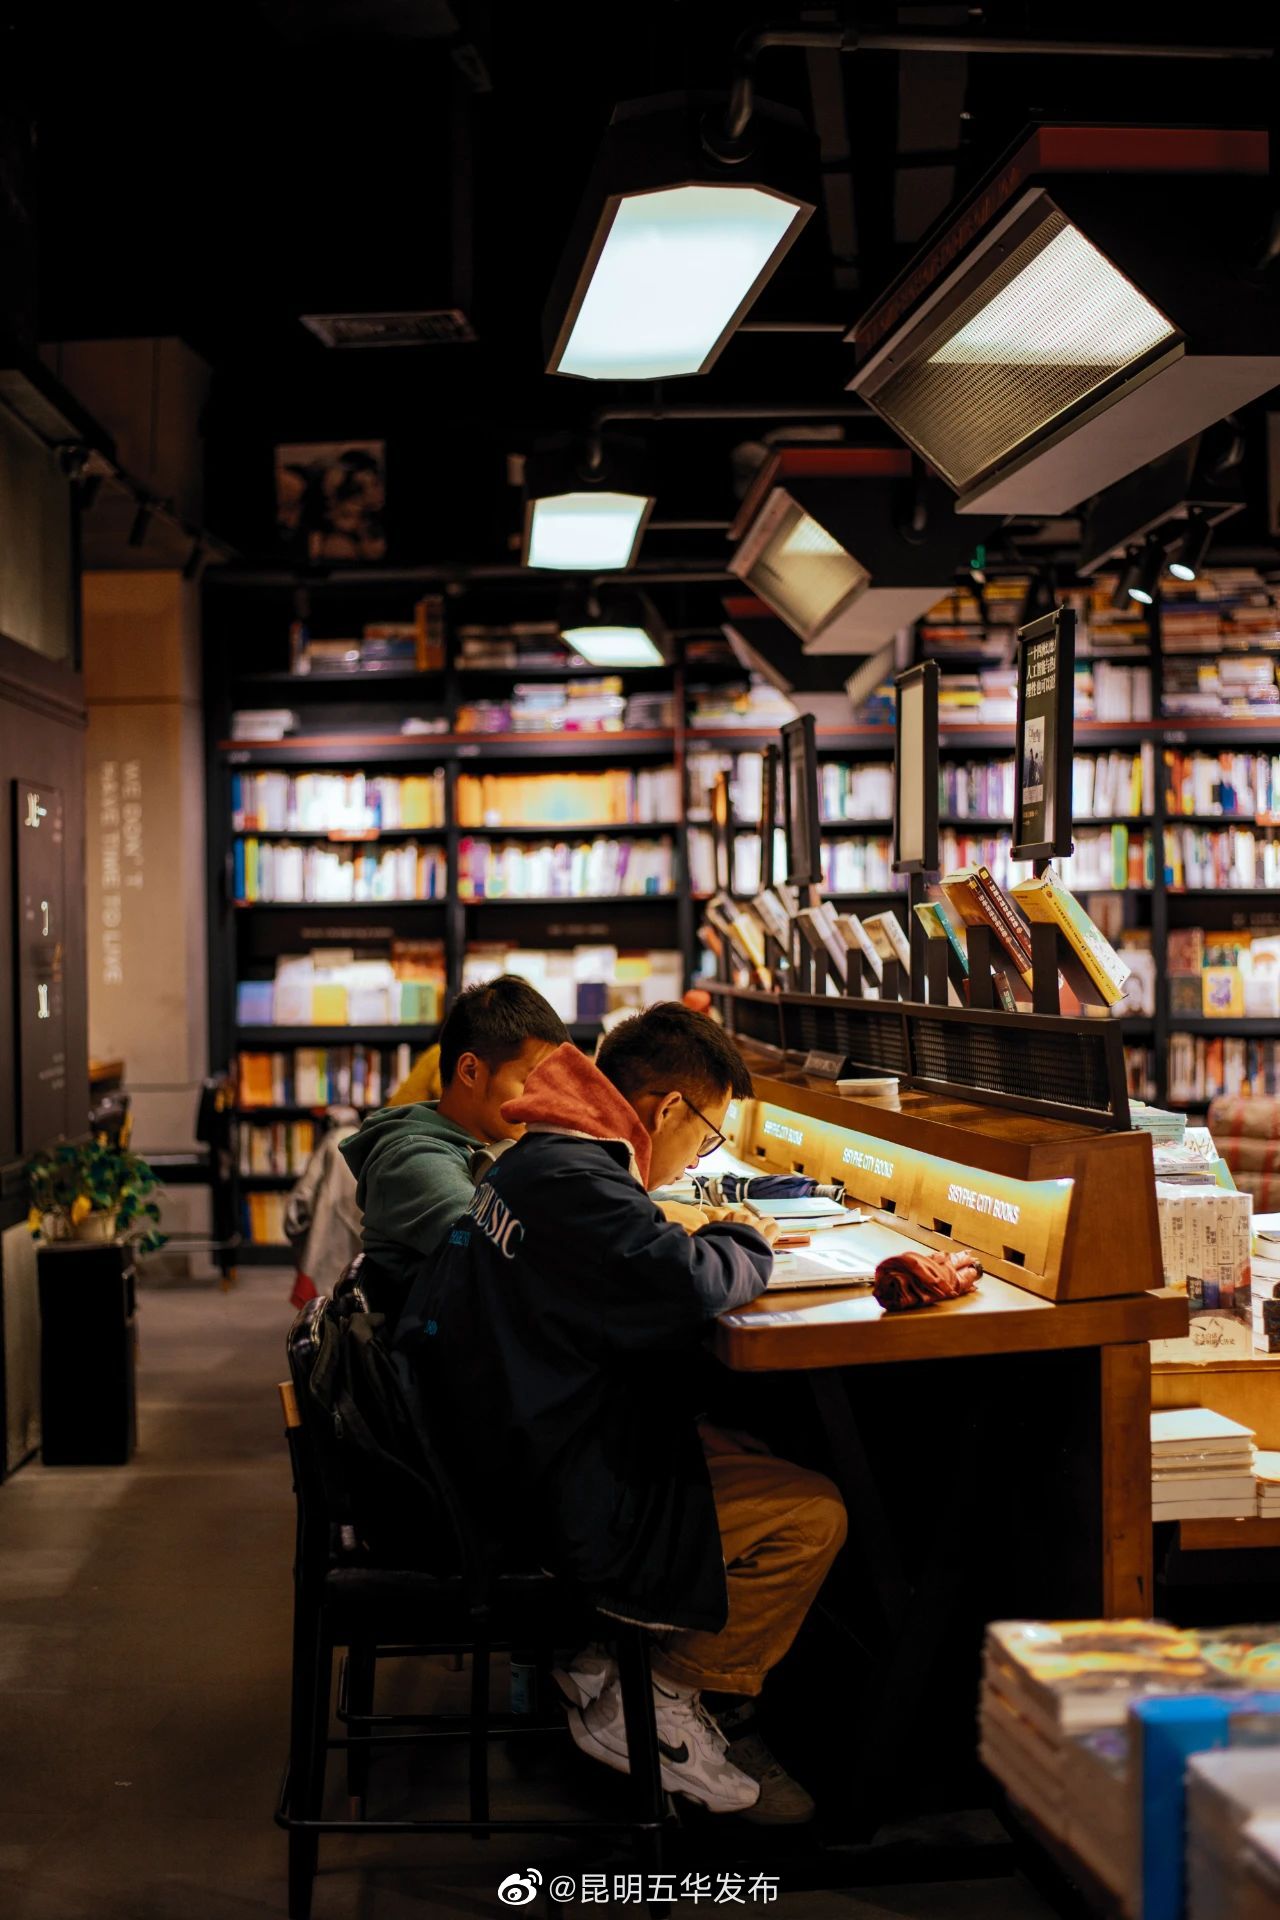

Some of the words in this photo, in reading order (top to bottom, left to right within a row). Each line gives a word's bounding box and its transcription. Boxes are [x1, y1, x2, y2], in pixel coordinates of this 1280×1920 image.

[102, 894, 122, 928] TO
[947, 1183, 978, 1210] SISYPHE
[976, 1193, 994, 1216] CITY
[992, 1198, 1021, 1226] BOOKS
